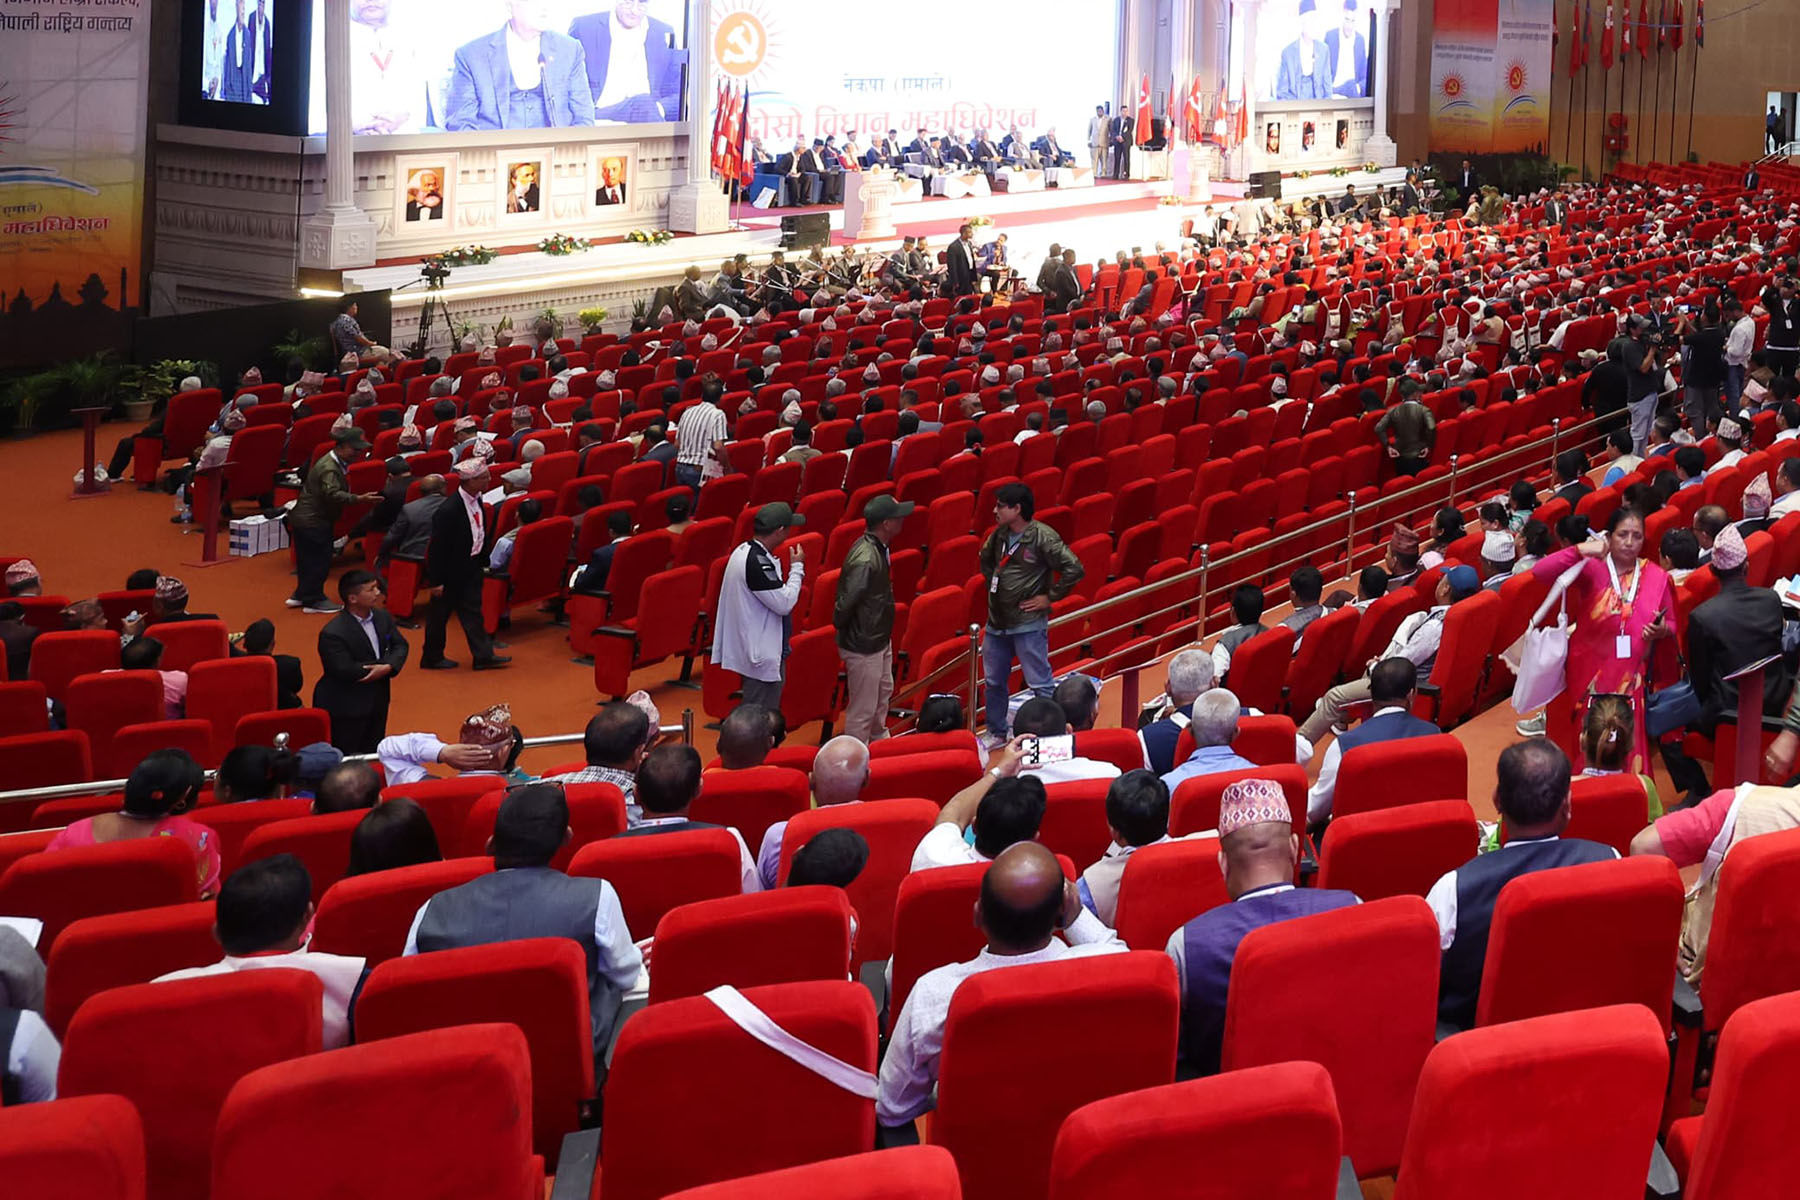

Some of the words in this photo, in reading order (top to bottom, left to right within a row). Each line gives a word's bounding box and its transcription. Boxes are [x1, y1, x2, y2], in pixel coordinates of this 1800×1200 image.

[43, 12, 84, 34] राष्ट्रिय
[86, 15, 134, 32] गन्तव्य
[814, 104, 891, 136] विधान
[901, 101, 1039, 134] महाधिवेशन
